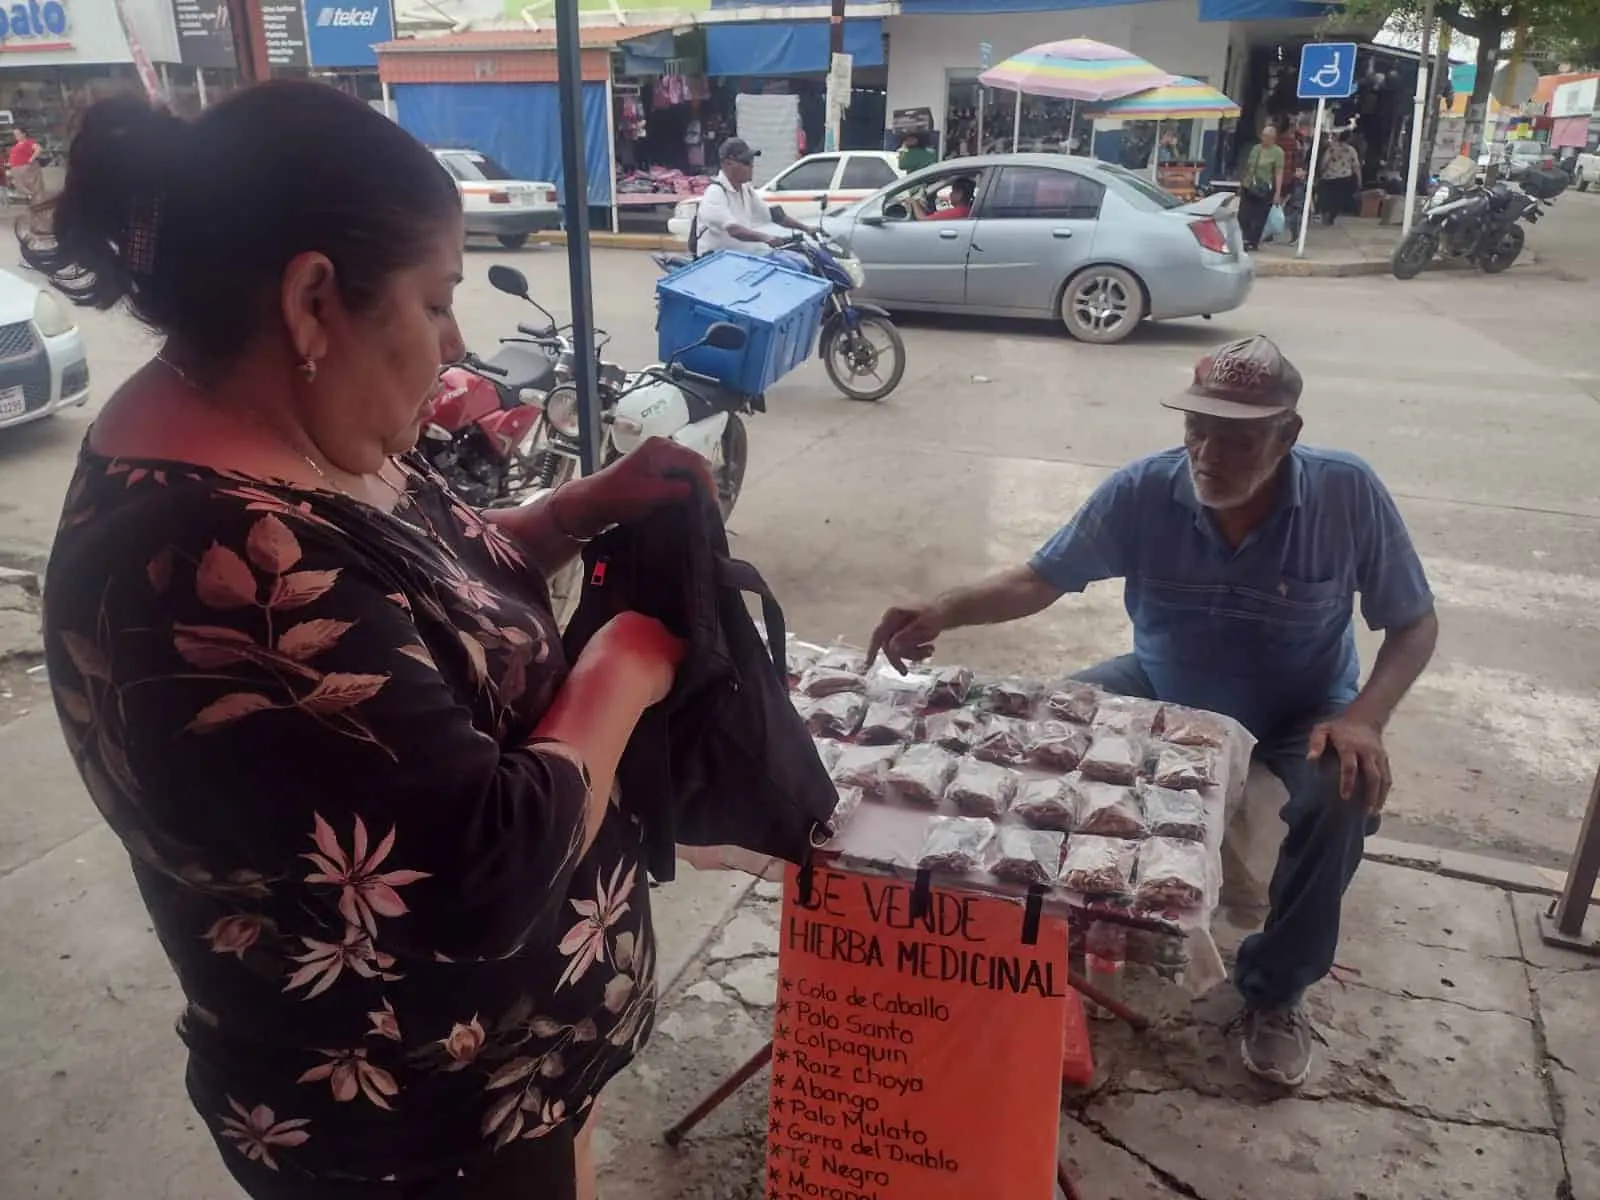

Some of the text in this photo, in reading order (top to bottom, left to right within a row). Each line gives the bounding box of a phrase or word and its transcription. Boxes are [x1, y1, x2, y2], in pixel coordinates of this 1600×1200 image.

[332, 6, 379, 27] telcel
[794, 868, 847, 917] SE
[789, 917, 1066, 998] HIERBA MEDICINAL
[795, 1001, 914, 1044] Palo Santo
[846, 985, 868, 1007] de
[873, 991, 950, 1021] Caballo
[791, 1075, 879, 1113] Abango
[792, 1050, 924, 1097] Raiz Choya
[788, 1098, 928, 1145] Palo Mulato
[784, 1145, 890, 1189] Té Negro
[786, 1122, 959, 1172] Garra del Diablo
